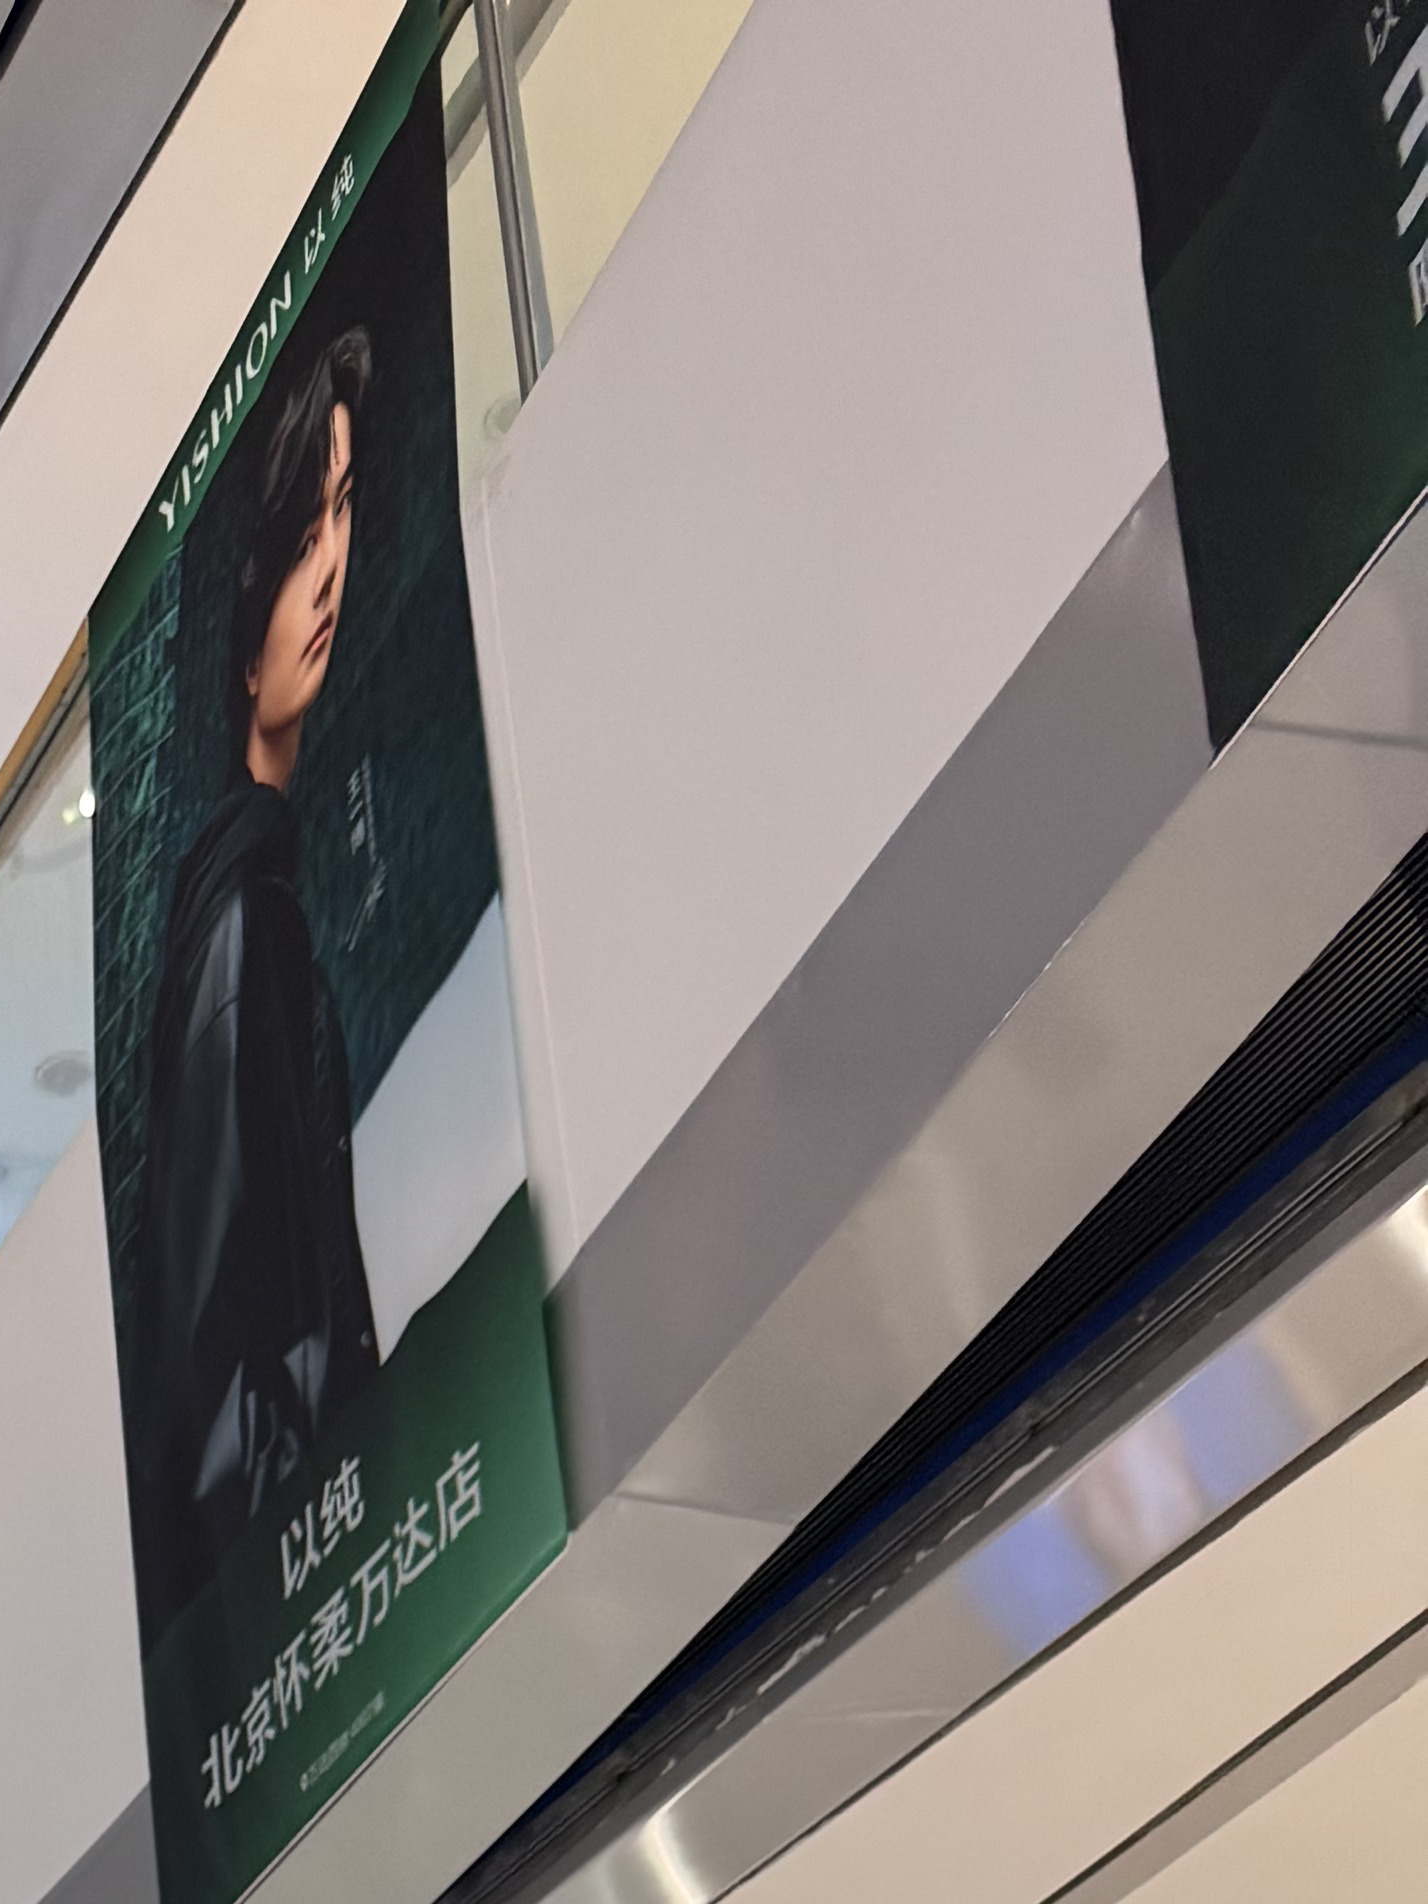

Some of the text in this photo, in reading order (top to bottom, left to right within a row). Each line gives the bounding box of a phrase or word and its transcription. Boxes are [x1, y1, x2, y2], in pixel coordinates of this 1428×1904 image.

[159, 153, 355, 532] YISHION 以纯
[201, 1441, 482, 1809] 北京怀柔万达店
[280, 1456, 365, 1600] 以纯
